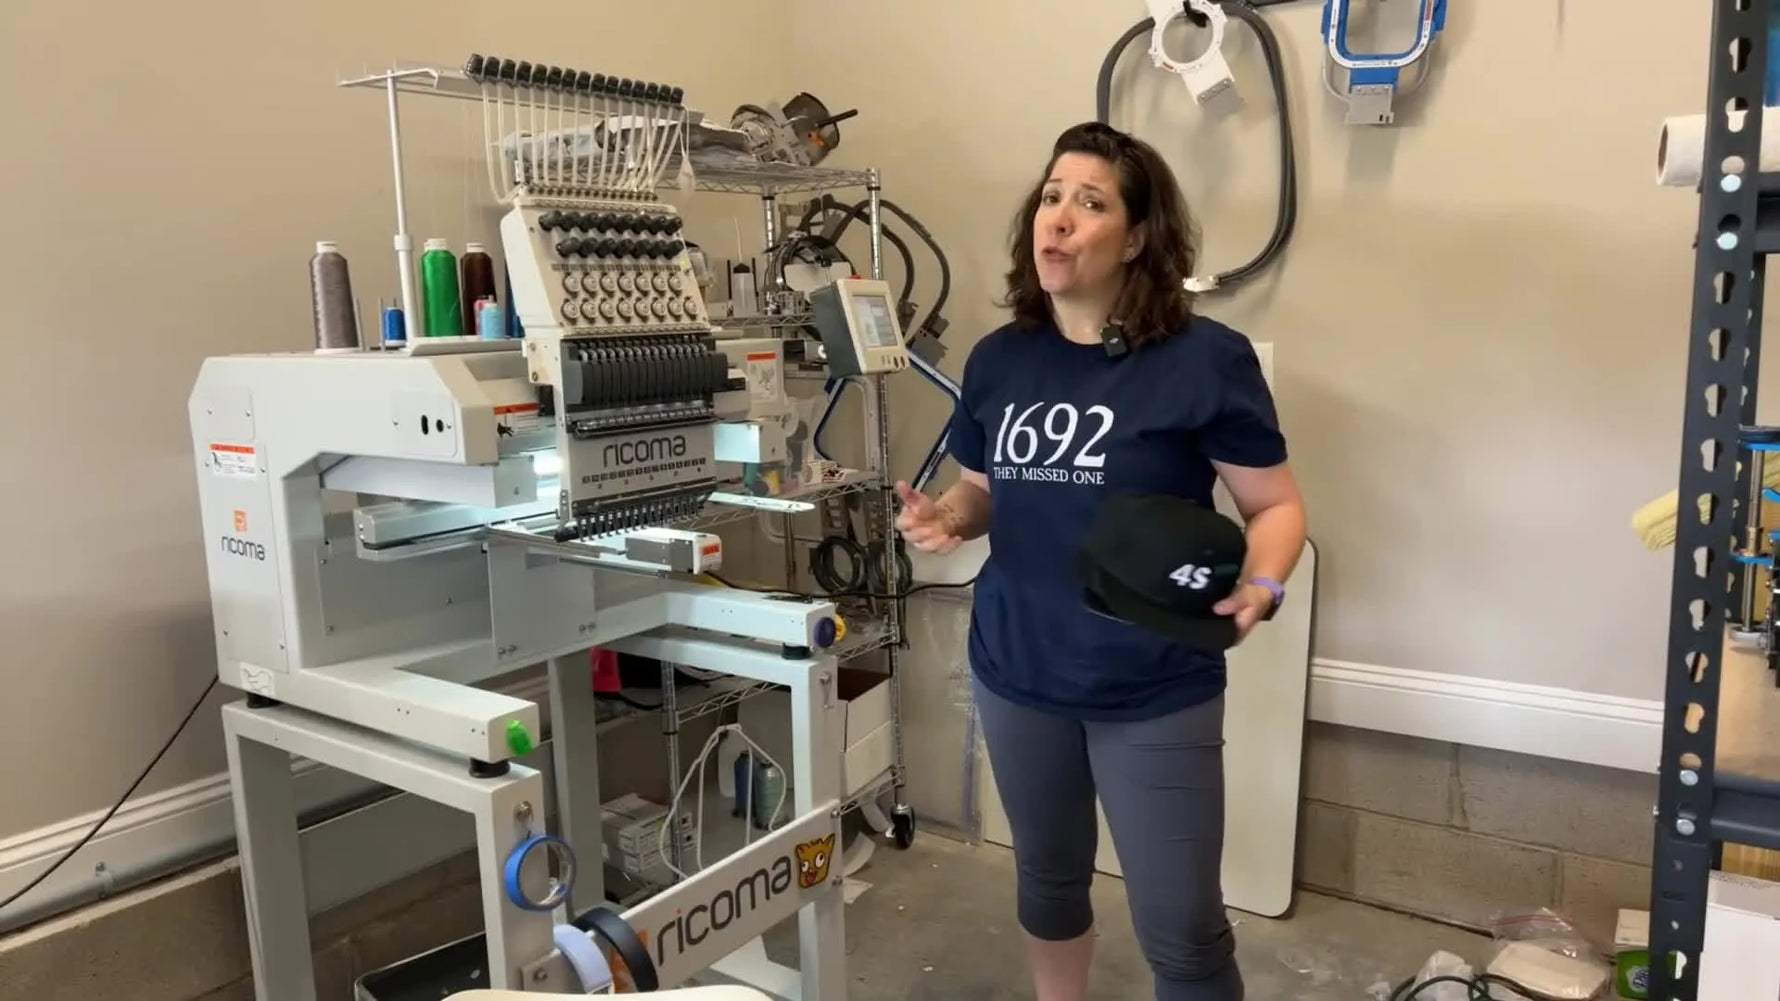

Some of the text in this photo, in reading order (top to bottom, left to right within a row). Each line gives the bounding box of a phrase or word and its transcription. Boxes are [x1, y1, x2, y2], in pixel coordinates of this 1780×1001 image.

[993, 401, 1115, 467] 1692
[603, 435, 686, 468] ricoma
[993, 466, 1106, 485] THEY MISSED ONE
[220, 535, 266, 561] ricoma
[1168, 563, 1213, 590] 4S
[656, 855, 792, 967] ricoma
